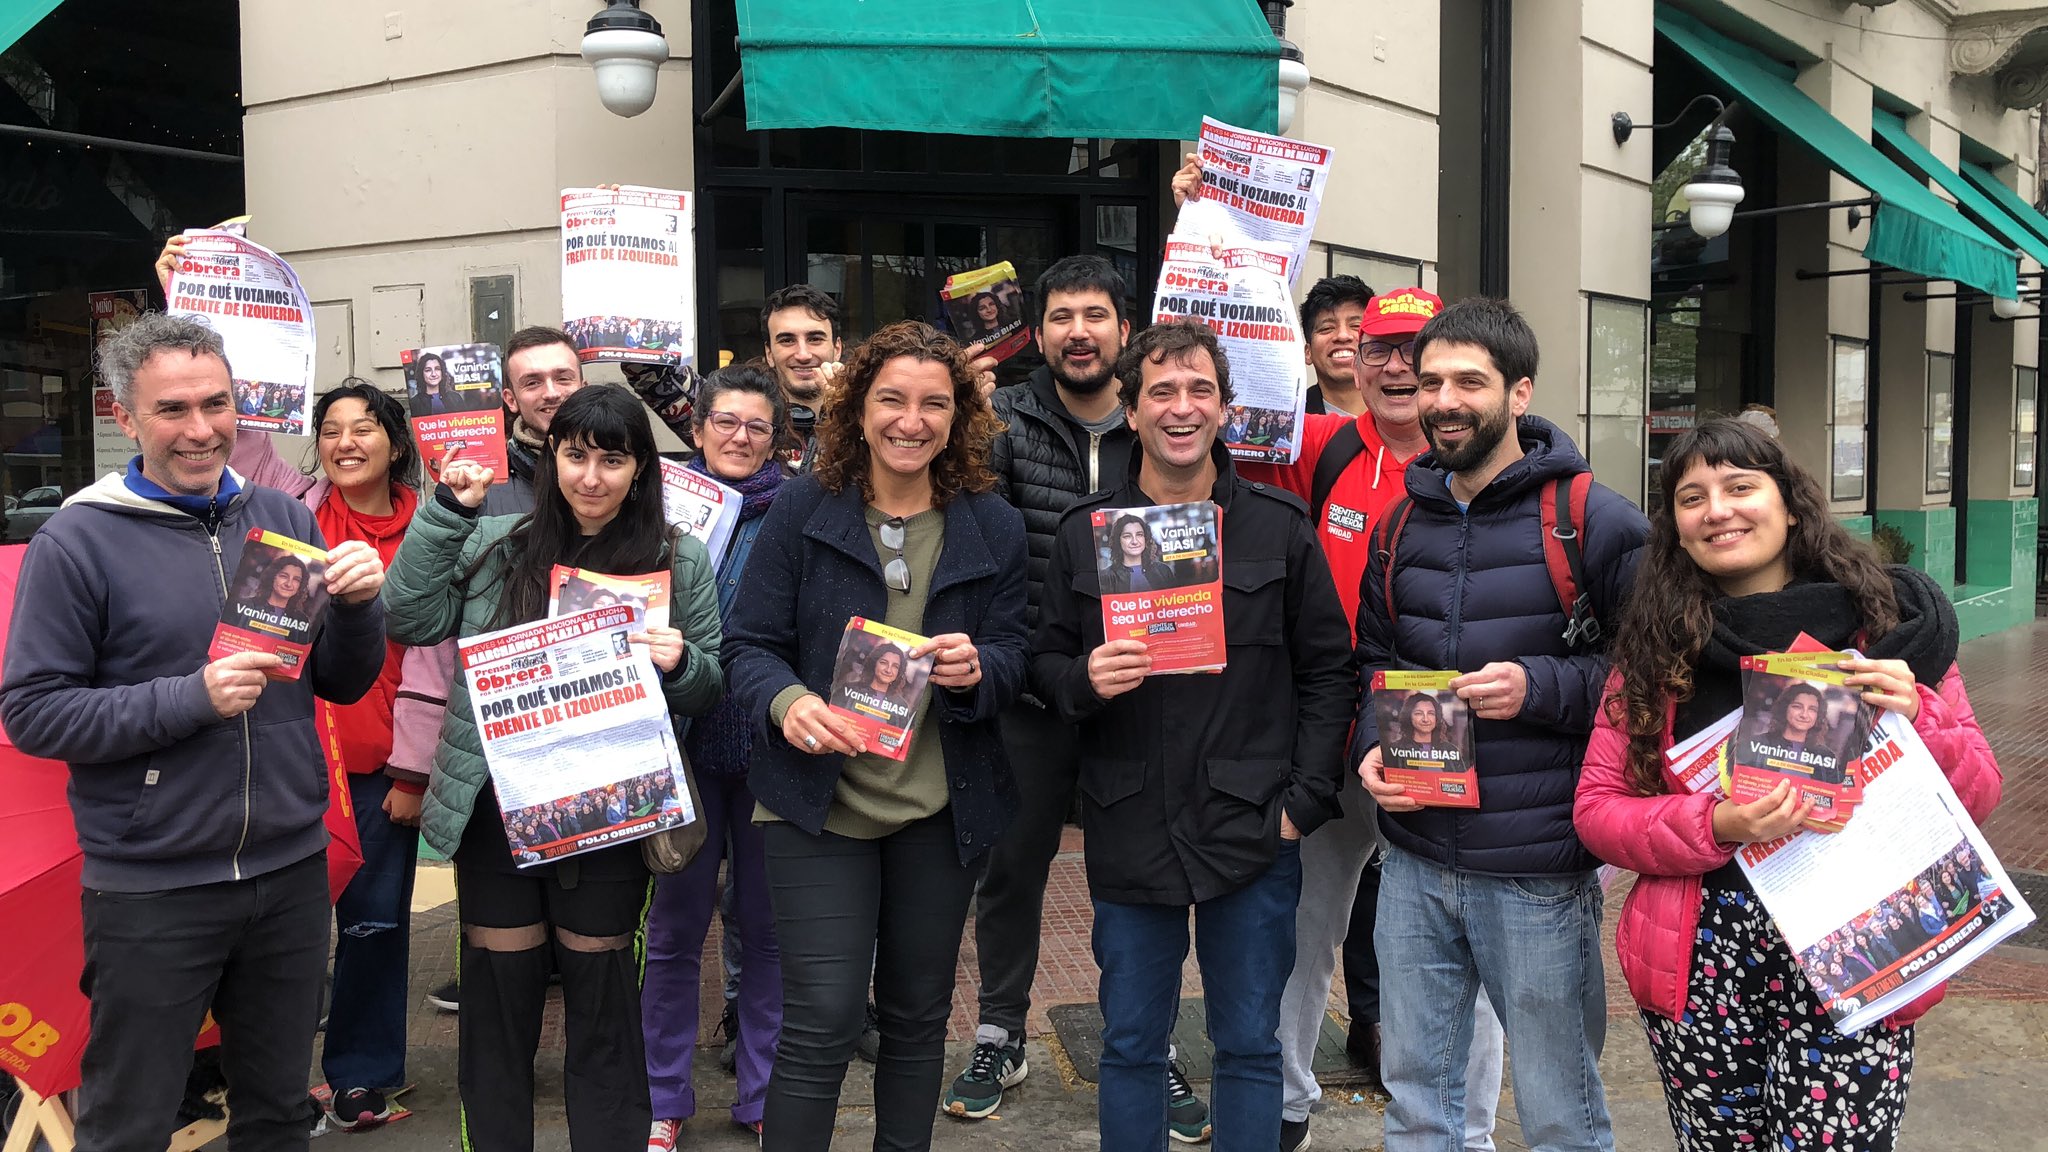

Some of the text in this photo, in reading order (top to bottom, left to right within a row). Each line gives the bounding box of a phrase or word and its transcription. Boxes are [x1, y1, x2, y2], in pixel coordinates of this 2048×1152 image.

[1204, 130, 1320, 162] MARCHAMOS PLAZA DE MAYO
[1204, 143, 1225, 155] Prensa
[1230, 132, 1259, 144] JORNADA
[1260, 138, 1291, 148] NACIONAL
[1300, 146, 1322, 154] LUCHA
[1203, 150, 1250, 174] Obrera
[1200, 169, 1308, 210] OR QUÉ VOTAMOS AL
[1200, 184, 1305, 225] RENTE DE IZQUIERDA
[566, 216, 616, 228] Obrera
[566, 231, 677, 253] POR QUÉ VOTAMOS AL
[566, 248, 678, 266] FRENTE DE IZQUIERDA
[1266, 254, 1282, 264] LUCHA
[182, 260, 240, 276] Obrera
[1168, 265, 1196, 274] Prensa
[1166, 272, 1229, 292] Obrera
[178, 281, 300, 308] POR QUÉ VOTAMOS AL
[1378, 293, 1434, 310] PARTIDO
[96, 298, 112, 314] MIÑO
[174, 296, 304, 322] FRENTE DE IZQUIERDA
[1159, 296, 1188, 314] POR
[1191, 298, 1217, 317] QUÉ
[1220, 304, 1282, 323] VOTAMOS
[1380, 303, 1434, 318] OBRERO
[969, 332, 1001, 345] Vanina
[1000, 320, 1022, 336] BIASI
[1208, 319, 1224, 336] DE
[1226, 322, 1296, 342] IZQUIERDA
[454, 362, 490, 373] Vanina
[454, 372, 480, 384] BIASI
[241, 420, 280, 428] OBRERO
[418, 415, 496, 431] Que la vivienda
[420, 426, 497, 441] sea un derecho
[1329, 504, 1364, 522] FRENTE DE
[1160, 525, 1205, 540] Vanina
[1162, 540, 1194, 552] BIASI
[1110, 590, 1212, 612] Que la vivienda
[236, 603, 278, 624] Vanina
[280, 616, 310, 632] BIASI
[1111, 604, 1213, 625] sea un derecho
[466, 641, 496, 654] JUEVES
[505, 628, 544, 644] JORNADA
[546, 616, 586, 633] NACIONAL
[598, 606, 626, 617] LUCHA
[467, 637, 540, 666] MARCHAMOS
[546, 625, 582, 644] PLAZA
[582, 620, 596, 633] DE
[596, 613, 628, 628] MAYO
[474, 664, 510, 677] Prensa
[476, 664, 552, 691] Obrera
[1806, 670, 1828, 678] Ciudad
[480, 664, 640, 722] POR QUÉ VOTAMOS AL
[505, 681, 528, 690] PARTIDO
[532, 676, 554, 684] OBRERO
[484, 683, 647, 740] FRENTE DE IZQUIERDA
[844, 686, 880, 706] Vanina
[880, 700, 908, 716] BIASI
[1872, 722, 1890, 744] AL
[1390, 747, 1460, 760] Vanina BIASI
[1750, 741, 1836, 769] Vanina BIASI
[1682, 752, 1716, 782] JUEVES 14
[578, 834, 608, 847] POLO
[610, 821, 656, 838] OBRERO
[544, 842, 578, 858] SUPLEMENTO
[1862, 916, 1982, 1002] SUPLEMENTO POLO OBRERO
